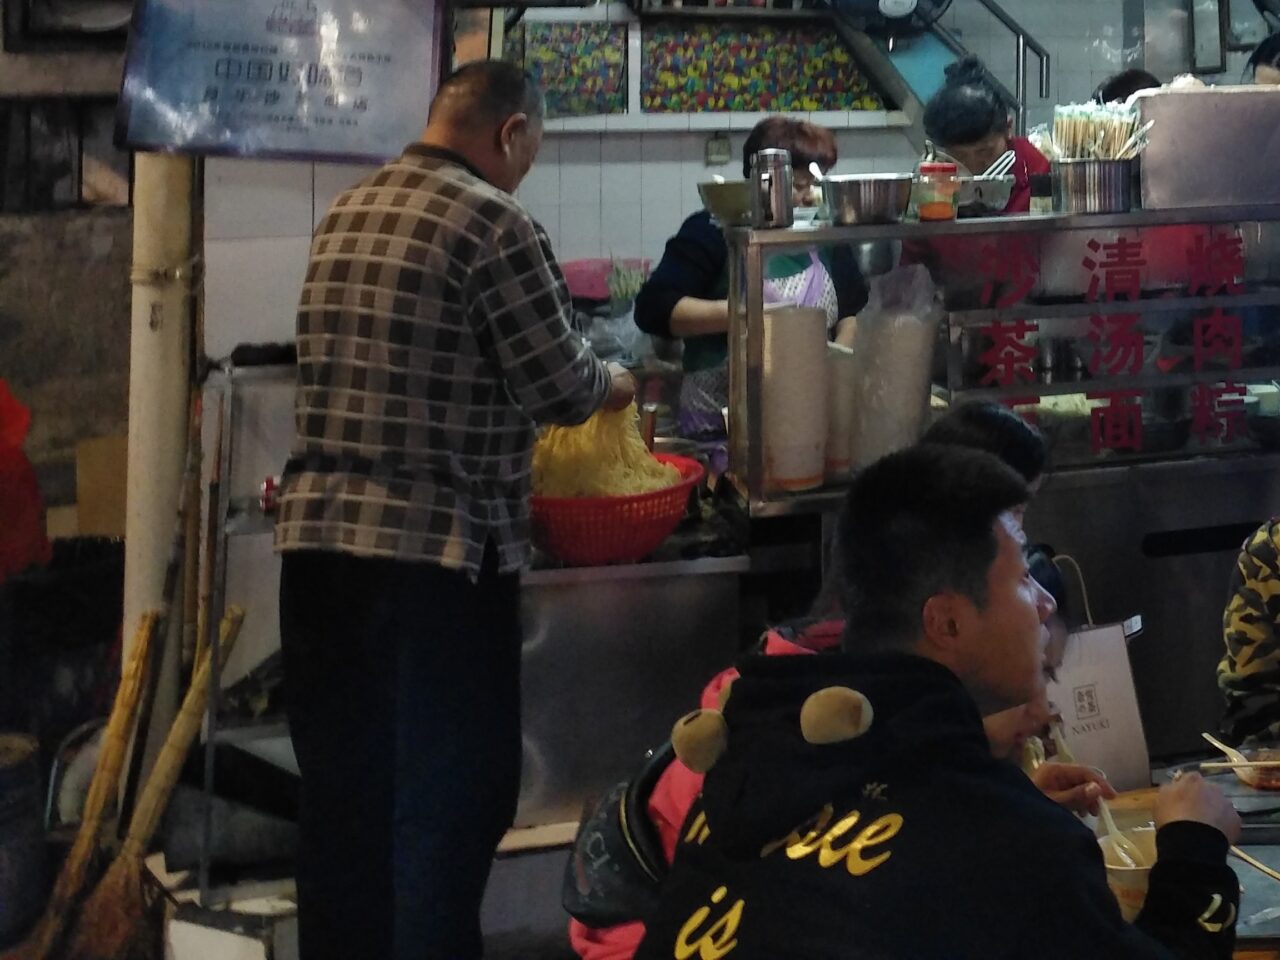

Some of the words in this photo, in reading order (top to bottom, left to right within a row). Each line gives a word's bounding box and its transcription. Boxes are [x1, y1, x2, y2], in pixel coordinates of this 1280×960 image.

[1082, 237, 1147, 452] 清汤面
[1187, 232, 1247, 442] 烧肉粽
